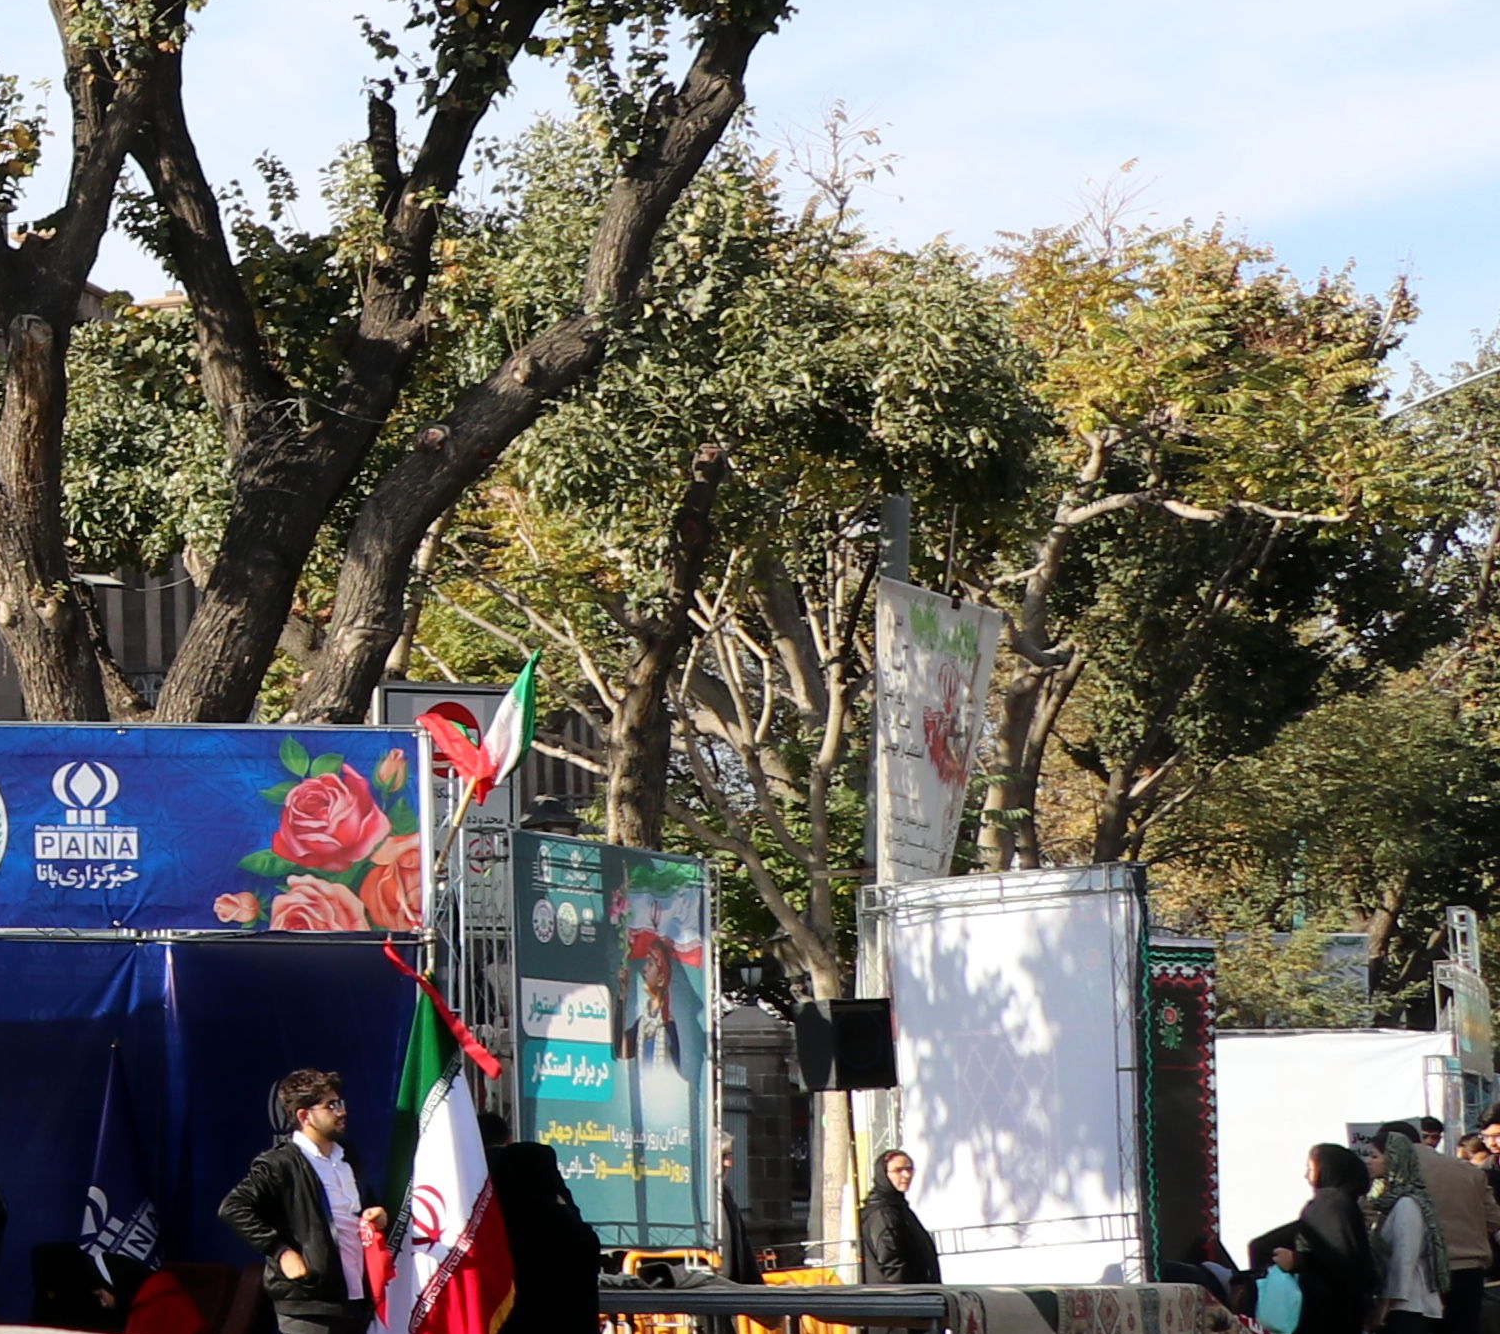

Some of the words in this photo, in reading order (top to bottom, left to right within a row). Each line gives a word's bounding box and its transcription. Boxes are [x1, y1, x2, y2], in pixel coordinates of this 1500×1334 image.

[38, 835, 136, 858] PANA
[36, 863, 59, 889] پانا
[58, 863, 139, 889] خبرگزاری
[528, 992, 562, 1022] استوار
[567, 1003, 575, 1026] و
[577, 999, 607, 1020] متحد
[531, 1051, 572, 1083] استکبار
[573, 1056, 597, 1087] برابر
